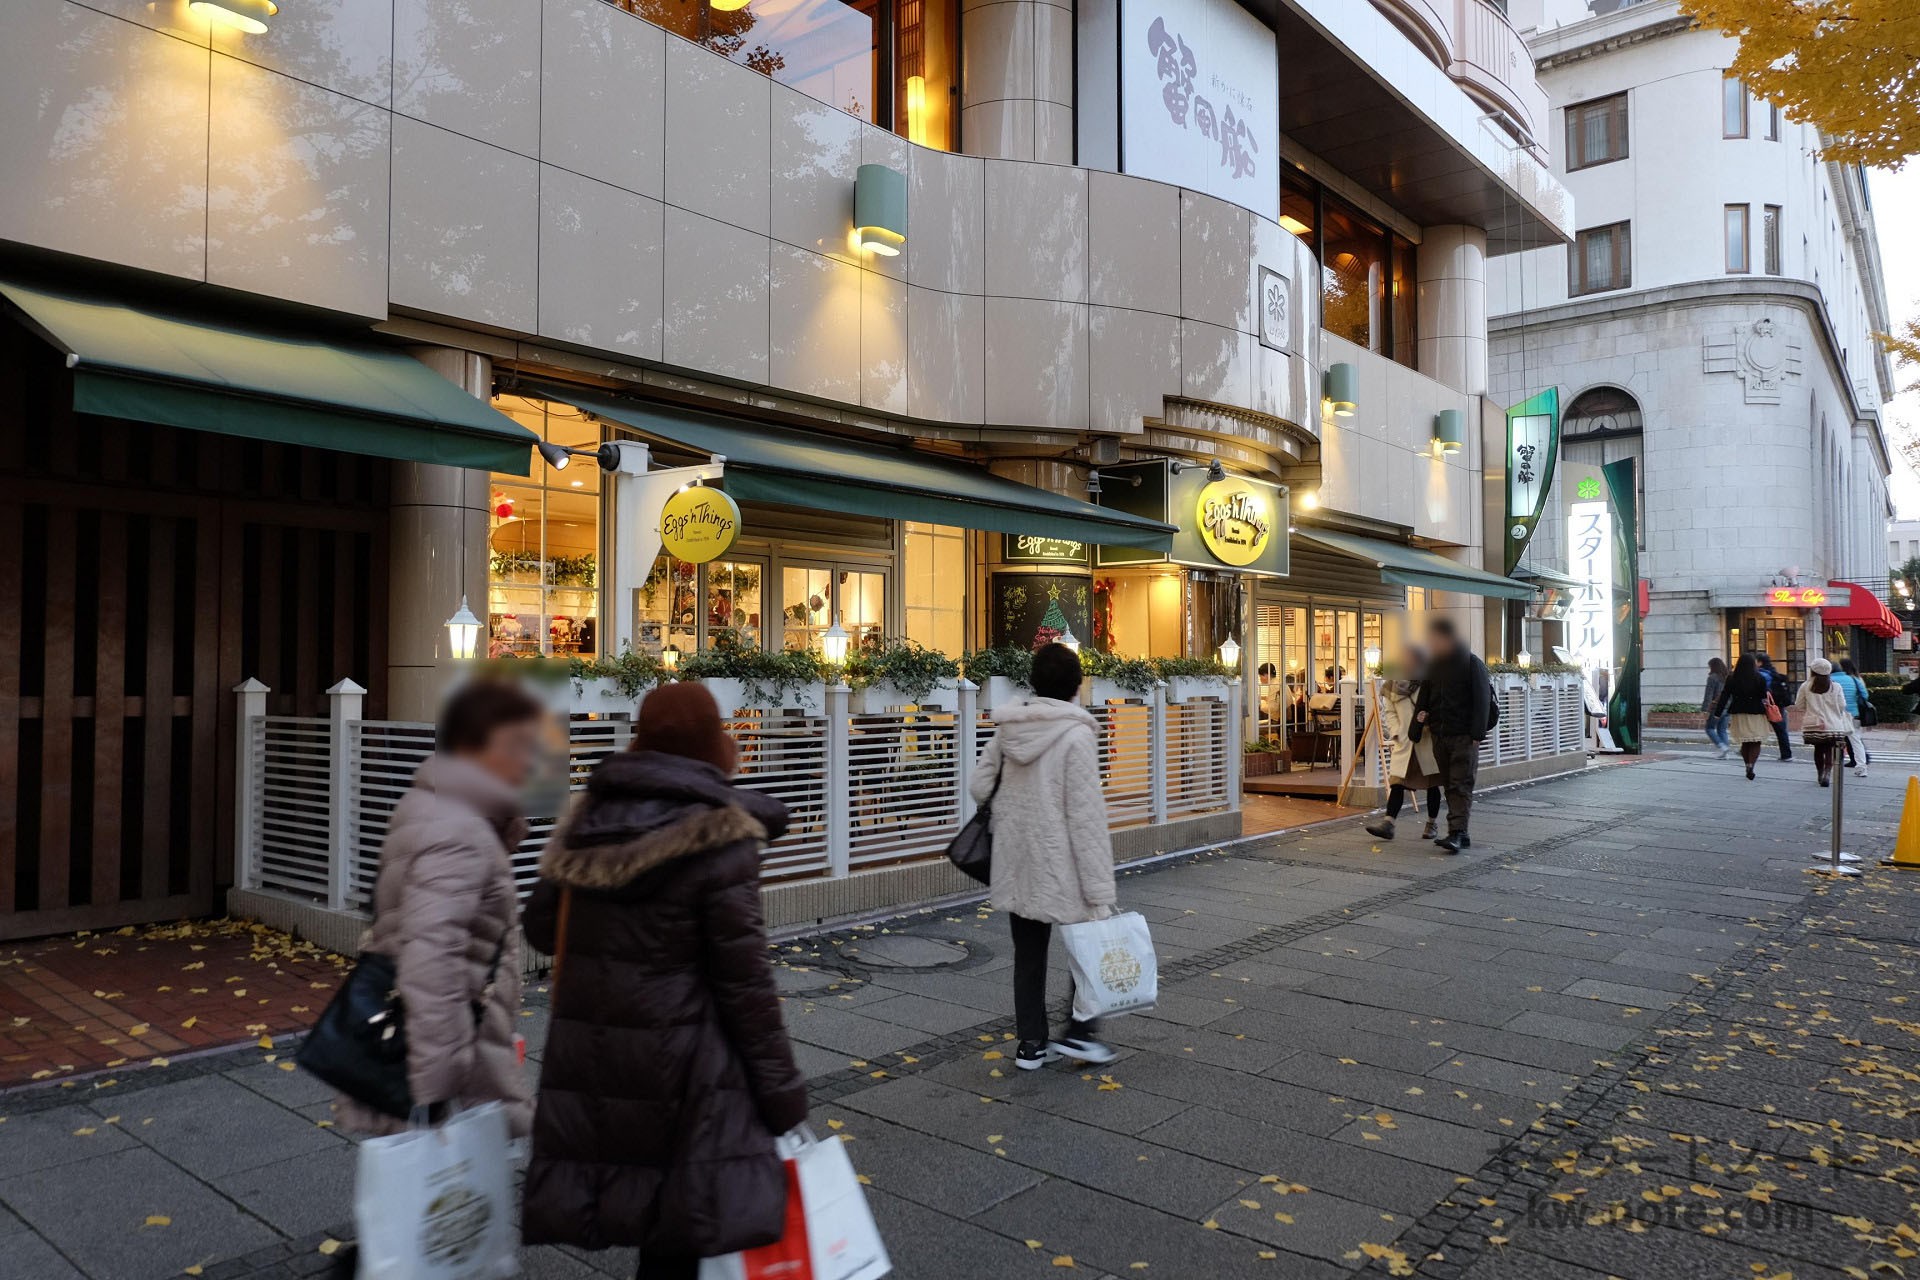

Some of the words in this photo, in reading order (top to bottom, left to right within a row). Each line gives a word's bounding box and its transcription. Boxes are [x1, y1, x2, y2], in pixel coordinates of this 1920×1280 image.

[664, 513, 689, 541] Eggs
[695, 502, 733, 540] Things
[1577, 513, 1605, 648] スターホテル
[1771, 590, 1796, 603] The
